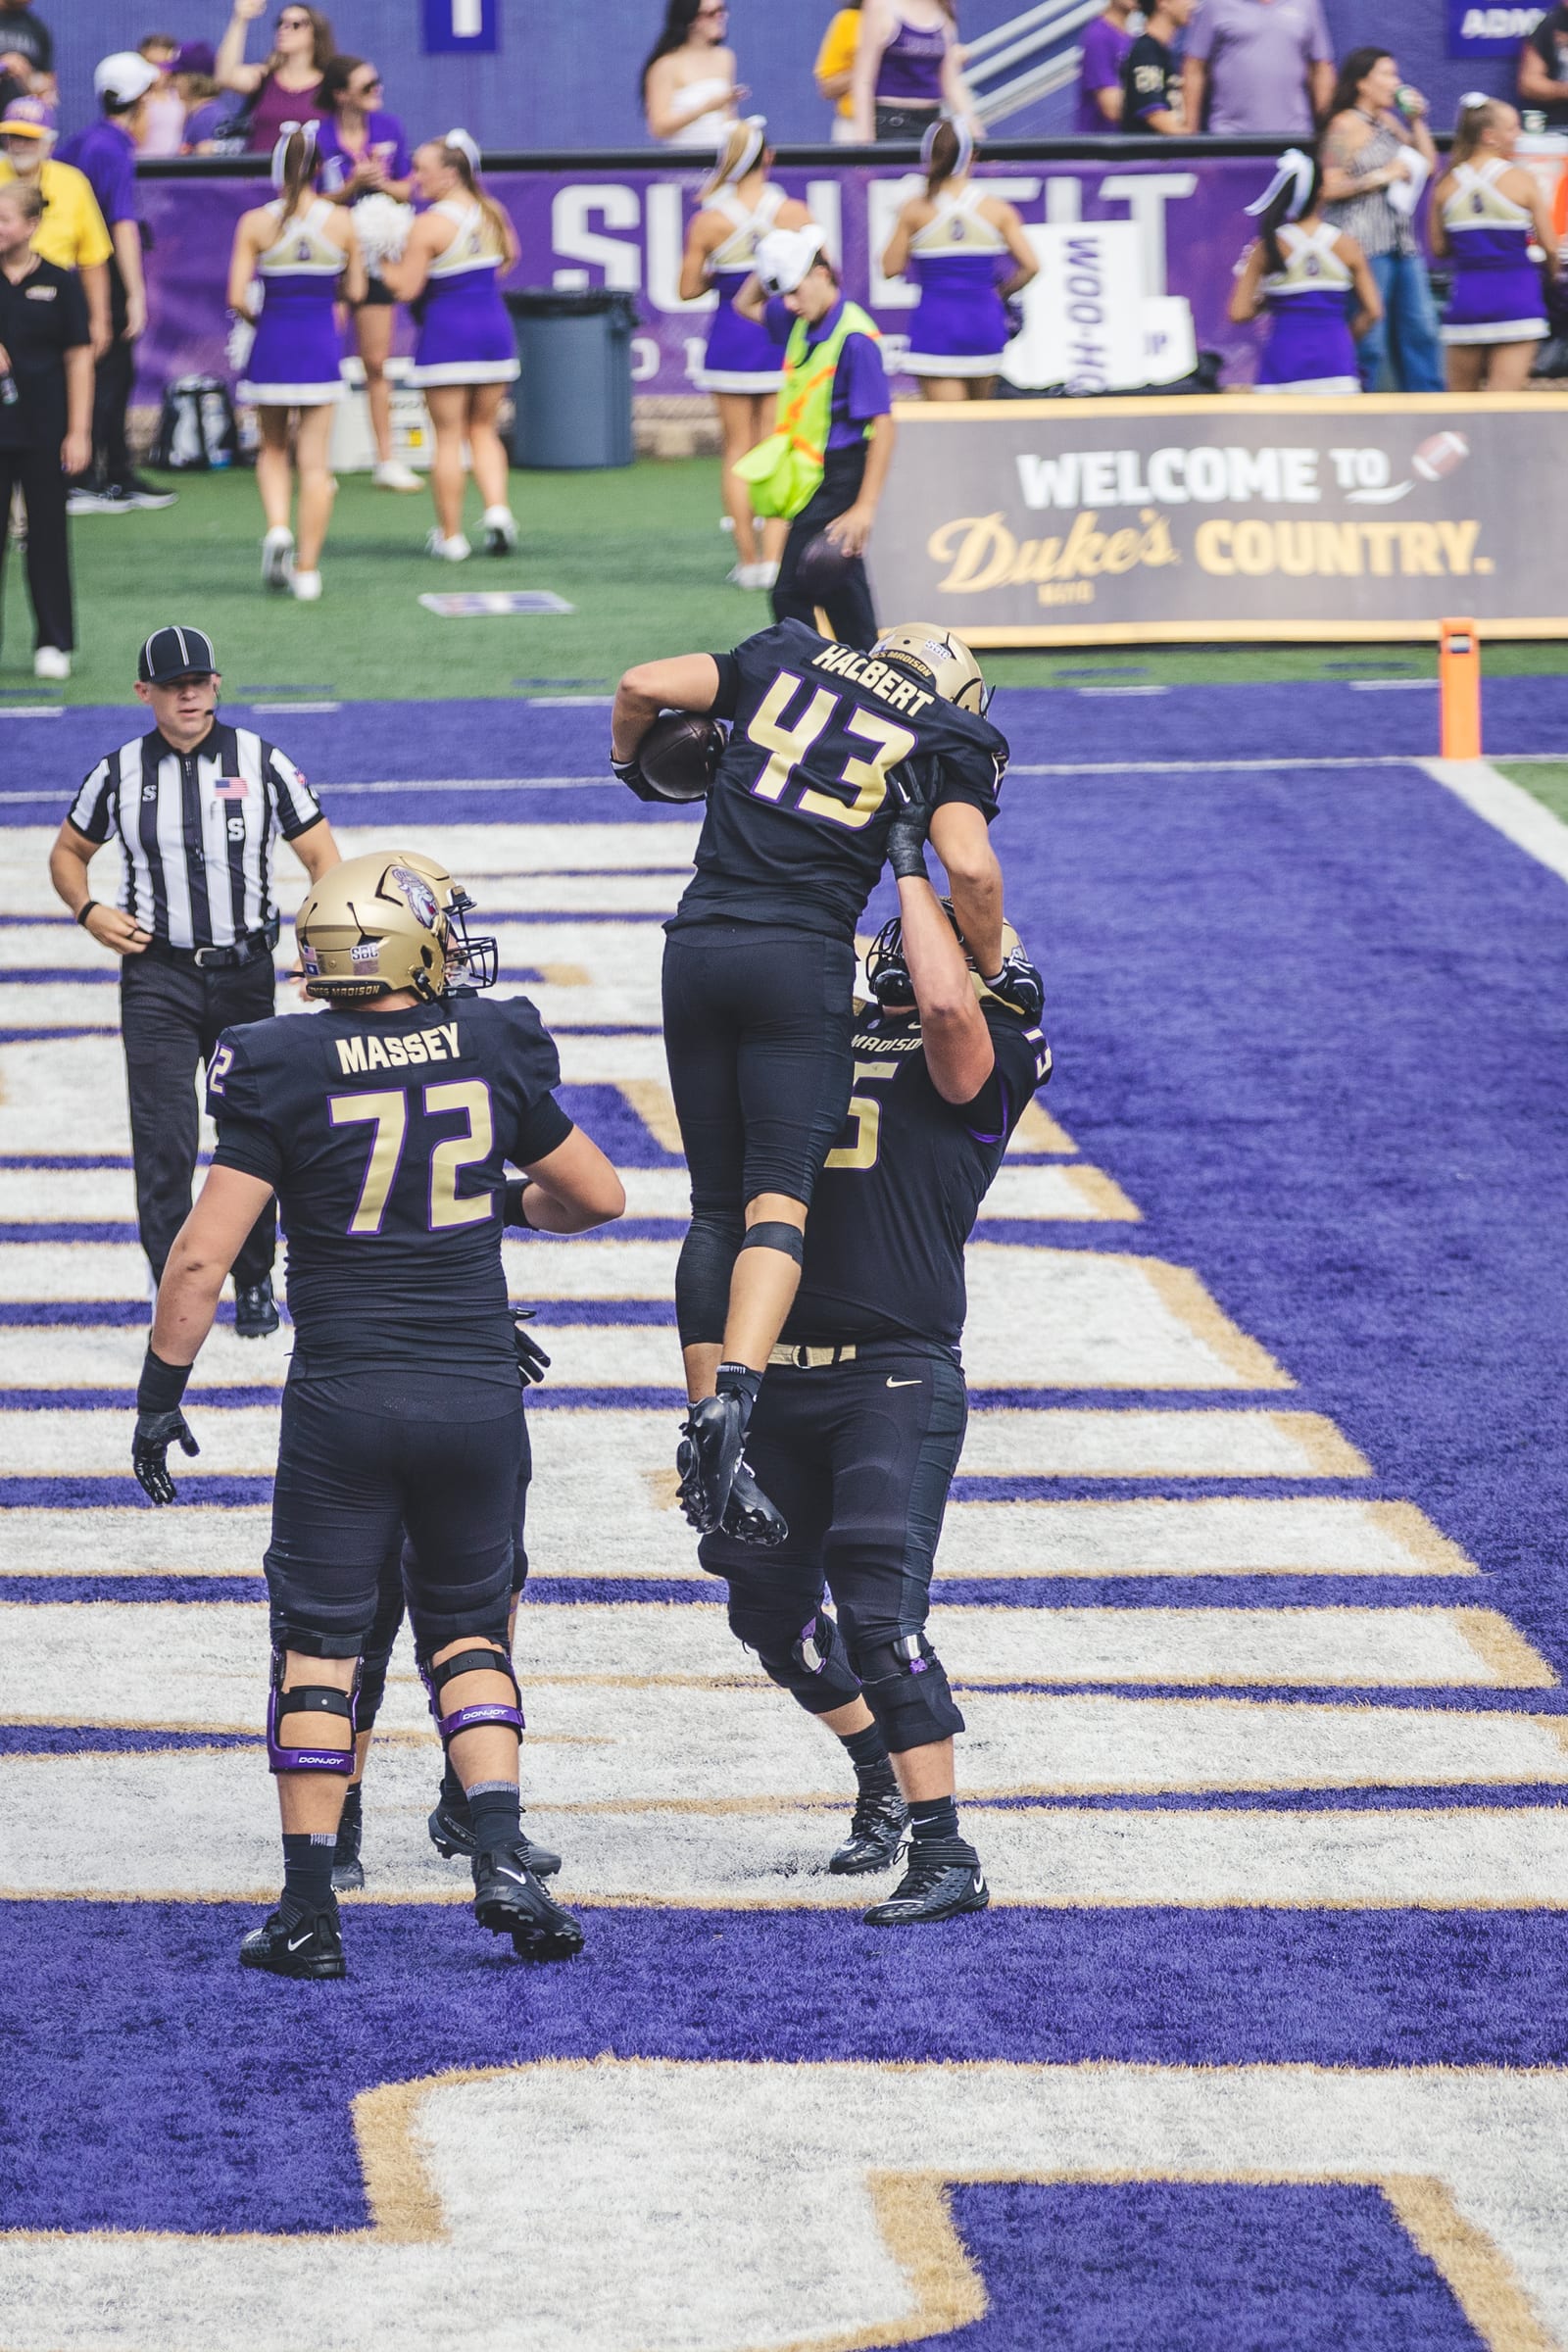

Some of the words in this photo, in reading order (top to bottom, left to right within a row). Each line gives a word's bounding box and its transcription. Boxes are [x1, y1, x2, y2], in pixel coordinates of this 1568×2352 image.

[1015, 447, 1322, 509] WELCOME
[1329, 448, 1391, 489] TO
[927, 509, 1179, 594] Duke's
[1195, 518, 1496, 576] COUNTRY.
[811, 644, 935, 717] HALBERT
[888, 650, 933, 678] MADISON
[746, 667, 918, 831] 43
[142, 785, 157, 802] S
[226, 817, 245, 842] S
[332, 985, 380, 997] MADISON
[335, 1021, 461, 1075] MASSEY
[326, 1077, 495, 1236] 72
[462, 1708, 509, 1721] DONJOY
[298, 1755, 344, 1766] DONJOY
